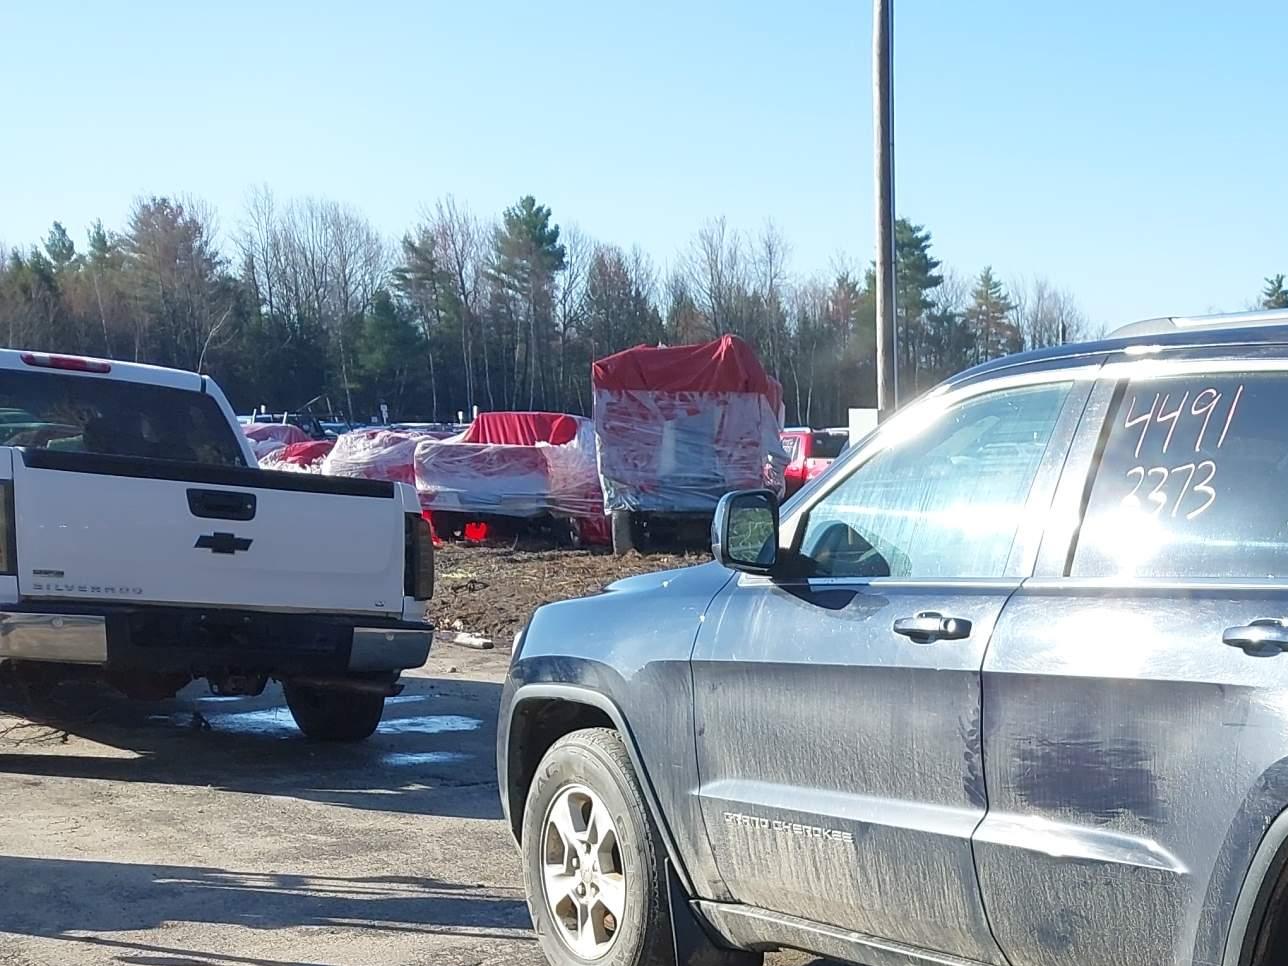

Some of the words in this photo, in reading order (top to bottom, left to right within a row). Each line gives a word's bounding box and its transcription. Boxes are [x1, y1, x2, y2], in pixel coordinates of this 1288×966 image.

[1124, 384, 1244, 458] 4491
[31, 583, 143, 595] SILVERADO
[723, 812, 769, 828] GRAND
[772, 820, 854, 843] CHEROKEE
